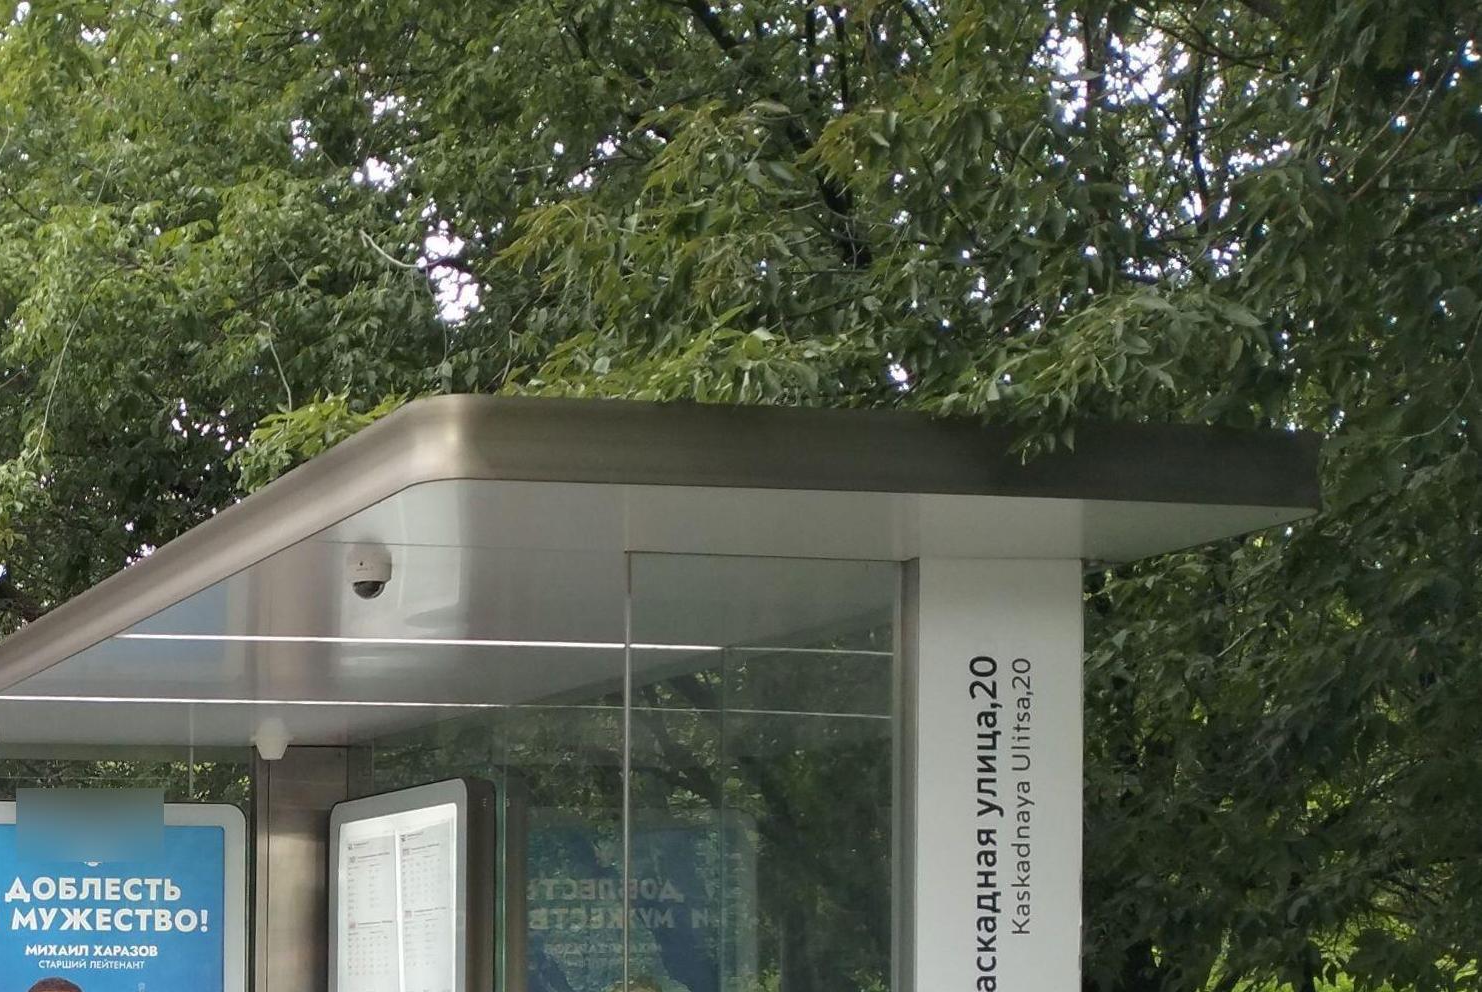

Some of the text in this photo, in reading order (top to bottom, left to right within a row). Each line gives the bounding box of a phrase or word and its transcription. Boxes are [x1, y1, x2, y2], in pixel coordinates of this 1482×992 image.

[968, 655, 1004, 818] улица,20
[1011, 657, 1035, 935] Kaskadnaya Ulitsa,20
[4, 876, 182, 903] ДОБЛЕСТЬ
[11, 906, 209, 933] МУЖЕСТВО!
[25, 944, 158, 957] МИХАИЛ ХАРАЗОВ
[38, 959, 145, 969] СТАРШИЙ ЛЕЙТЕНАНТ
